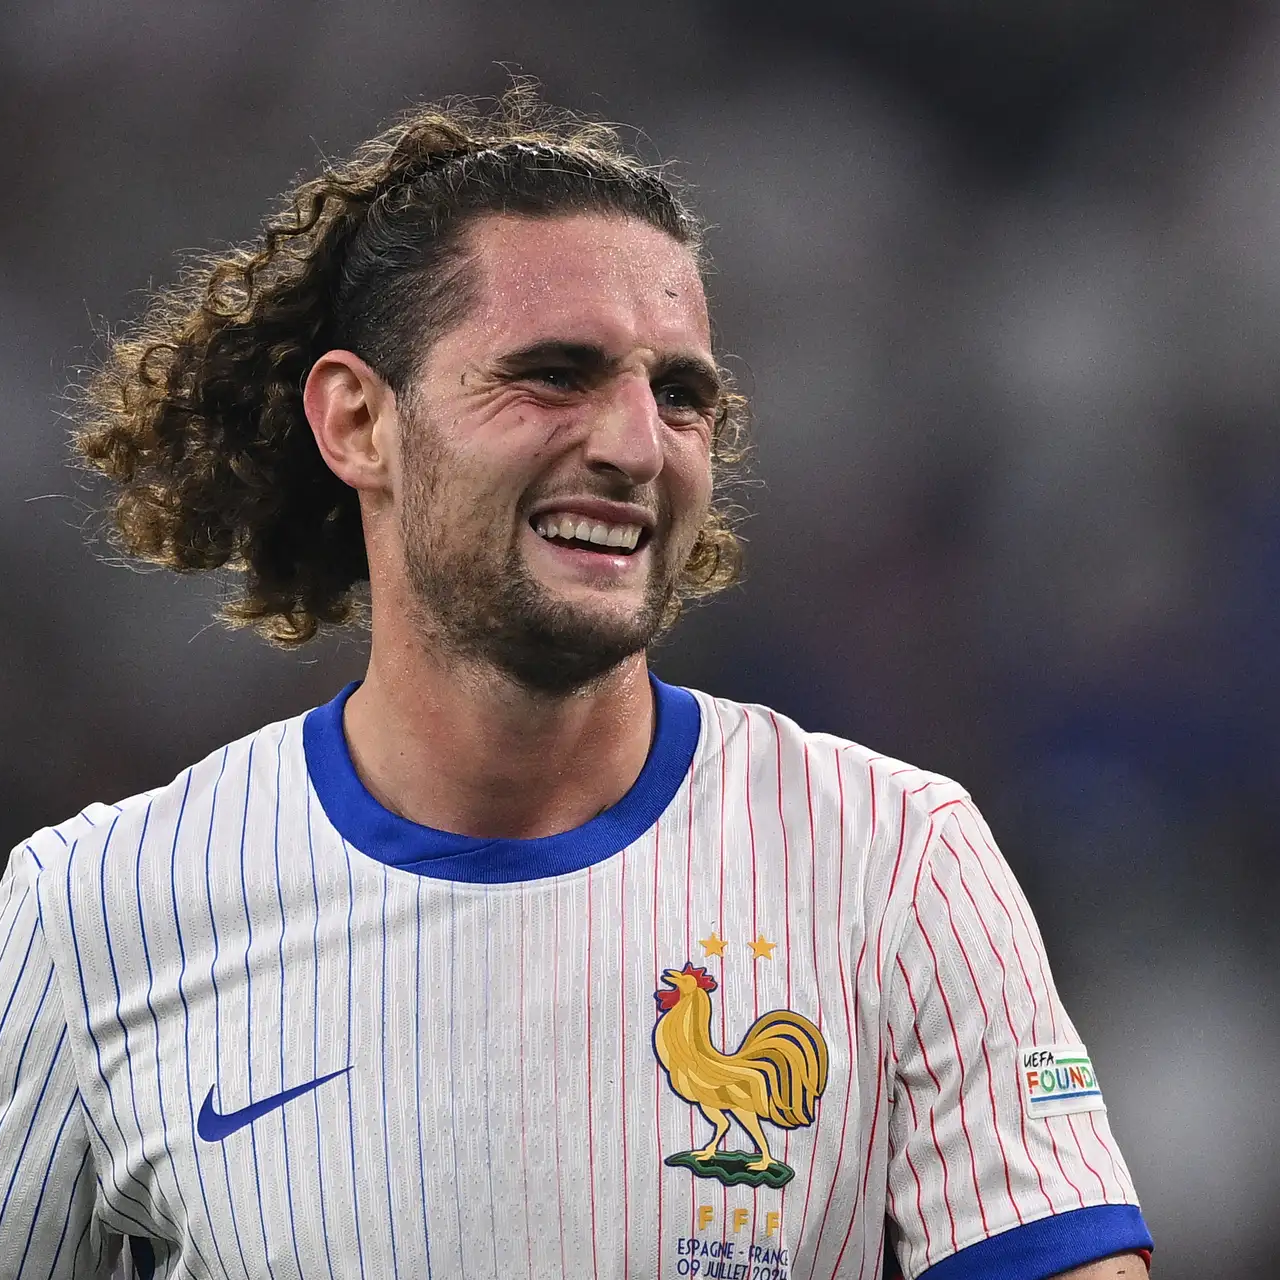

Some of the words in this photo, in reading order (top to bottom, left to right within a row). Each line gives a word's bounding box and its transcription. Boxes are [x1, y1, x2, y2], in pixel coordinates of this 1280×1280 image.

[1023, 1051, 1054, 1068] UEFA
[1026, 1066, 1097, 1094] FOUND
[677, 1238, 735, 1260] ESPAGNE
[748, 1245, 789, 1266] FRANCE
[677, 1259, 701, 1276] 09
[704, 1261, 749, 1280] JUILLET
